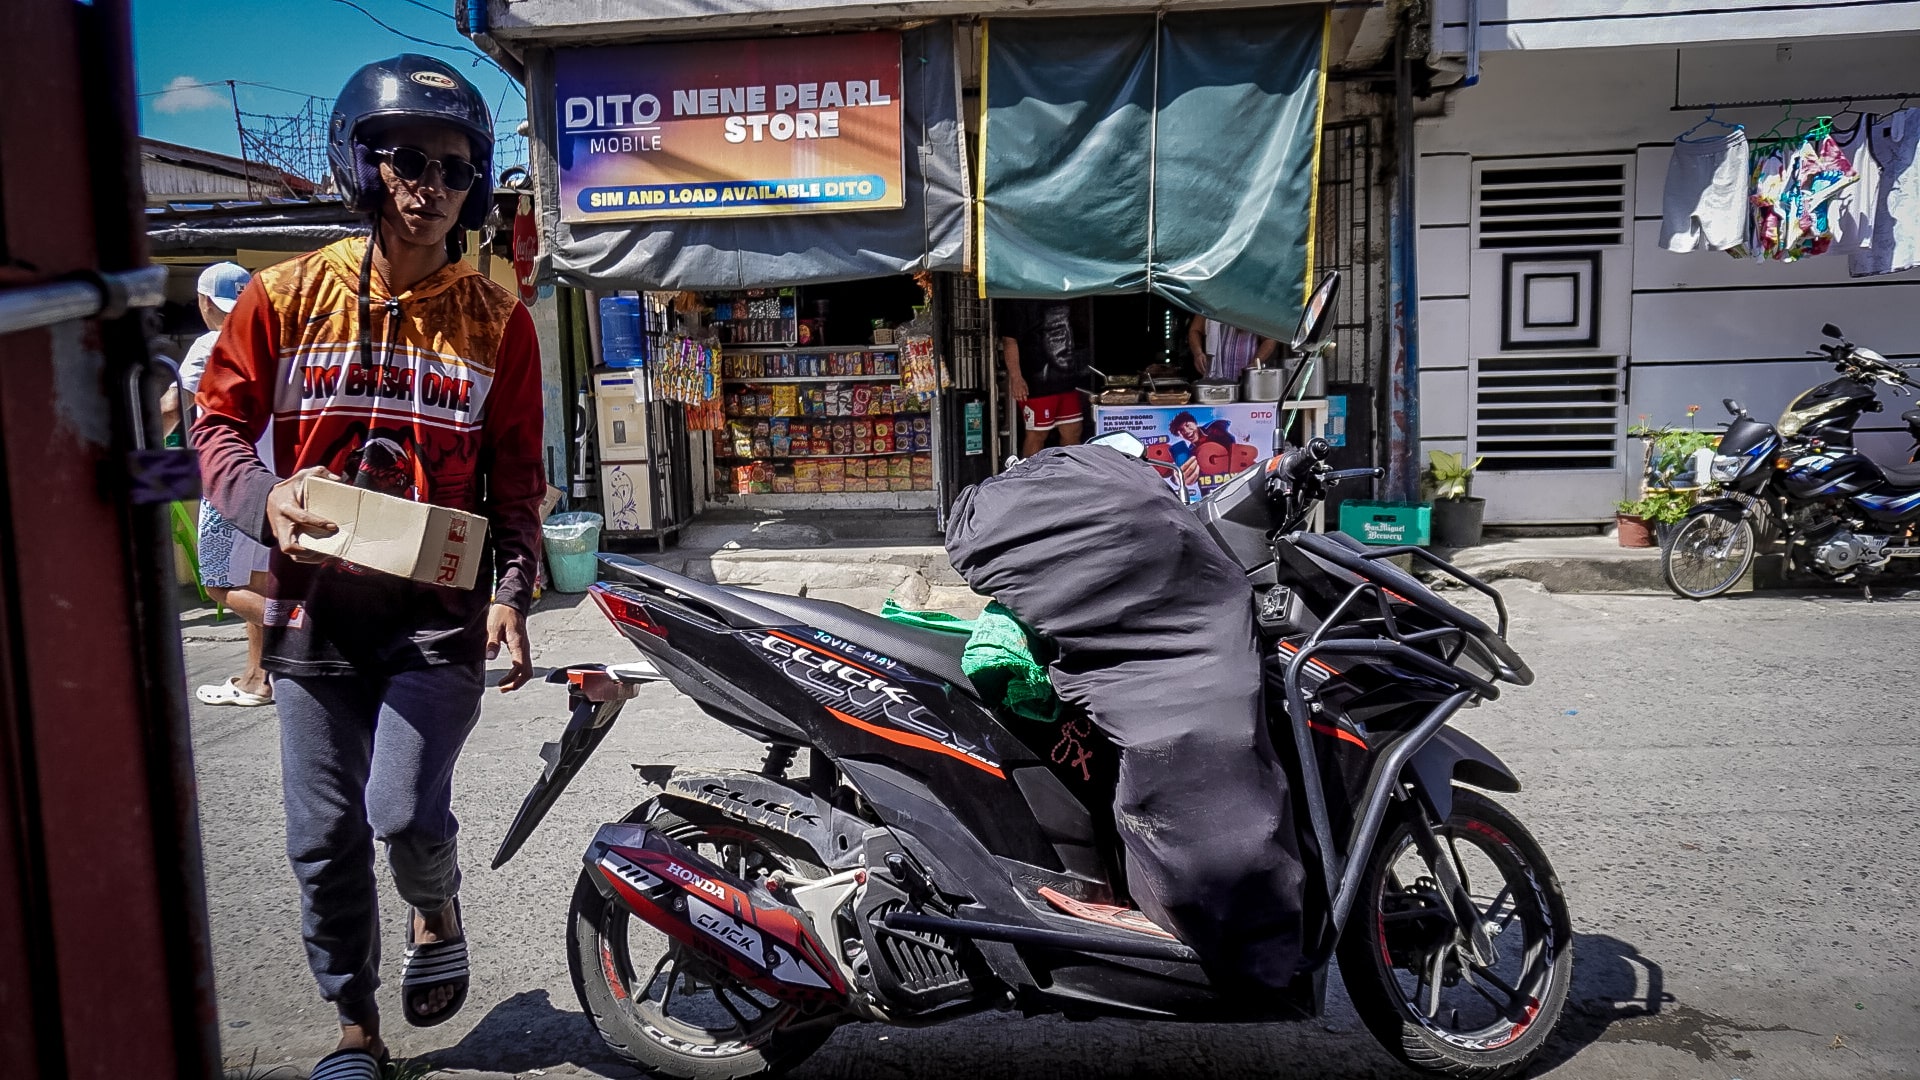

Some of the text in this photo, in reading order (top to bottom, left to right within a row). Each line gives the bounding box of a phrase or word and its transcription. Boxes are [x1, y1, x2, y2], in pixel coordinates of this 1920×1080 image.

[565, 94, 661, 128] DITO
[673, 79, 891, 116] NENE PEARL
[724, 111, 839, 143] STORE
[590, 135, 662, 154] MOBILE
[590, 181, 872, 207] SIM AND LOAD AVAILABLE DITO
[421, 372, 474, 412] ONE
[1250, 411, 1273, 419] DITO
[1199, 476, 1211, 486] 15
[1364, 522, 1405, 532] San Miguel
[1367, 531, 1402, 540] Brewery
[762, 635, 907, 704] CLICK
[862, 651, 897, 669] MAY
[702, 783, 822, 826] CLICK
[666, 862, 725, 901] HONDA
[696, 913, 755, 951] CLICK
